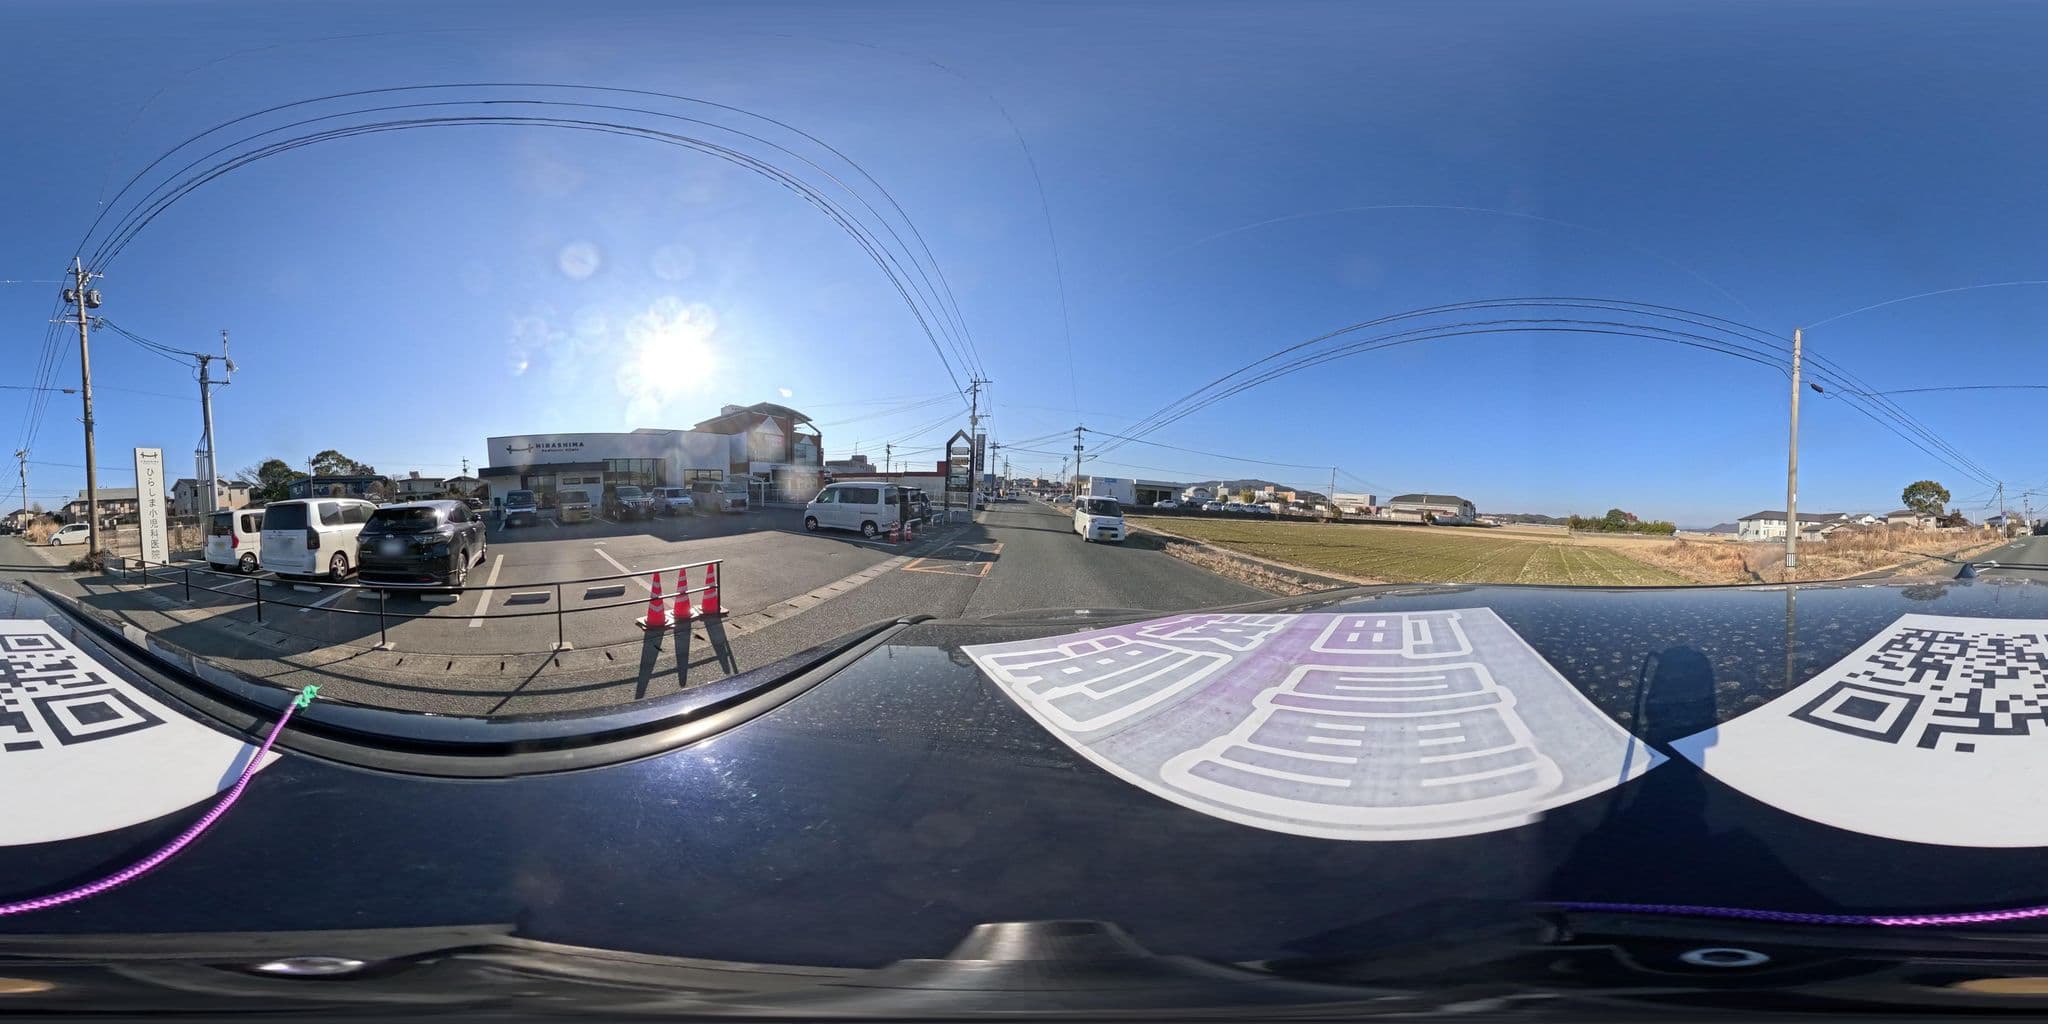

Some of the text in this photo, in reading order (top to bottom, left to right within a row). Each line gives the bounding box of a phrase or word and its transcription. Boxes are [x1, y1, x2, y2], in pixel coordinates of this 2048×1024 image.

[535, 441, 585, 449] HIRASHIMA
[146, 467, 161, 560] ひらしま小児科医院
